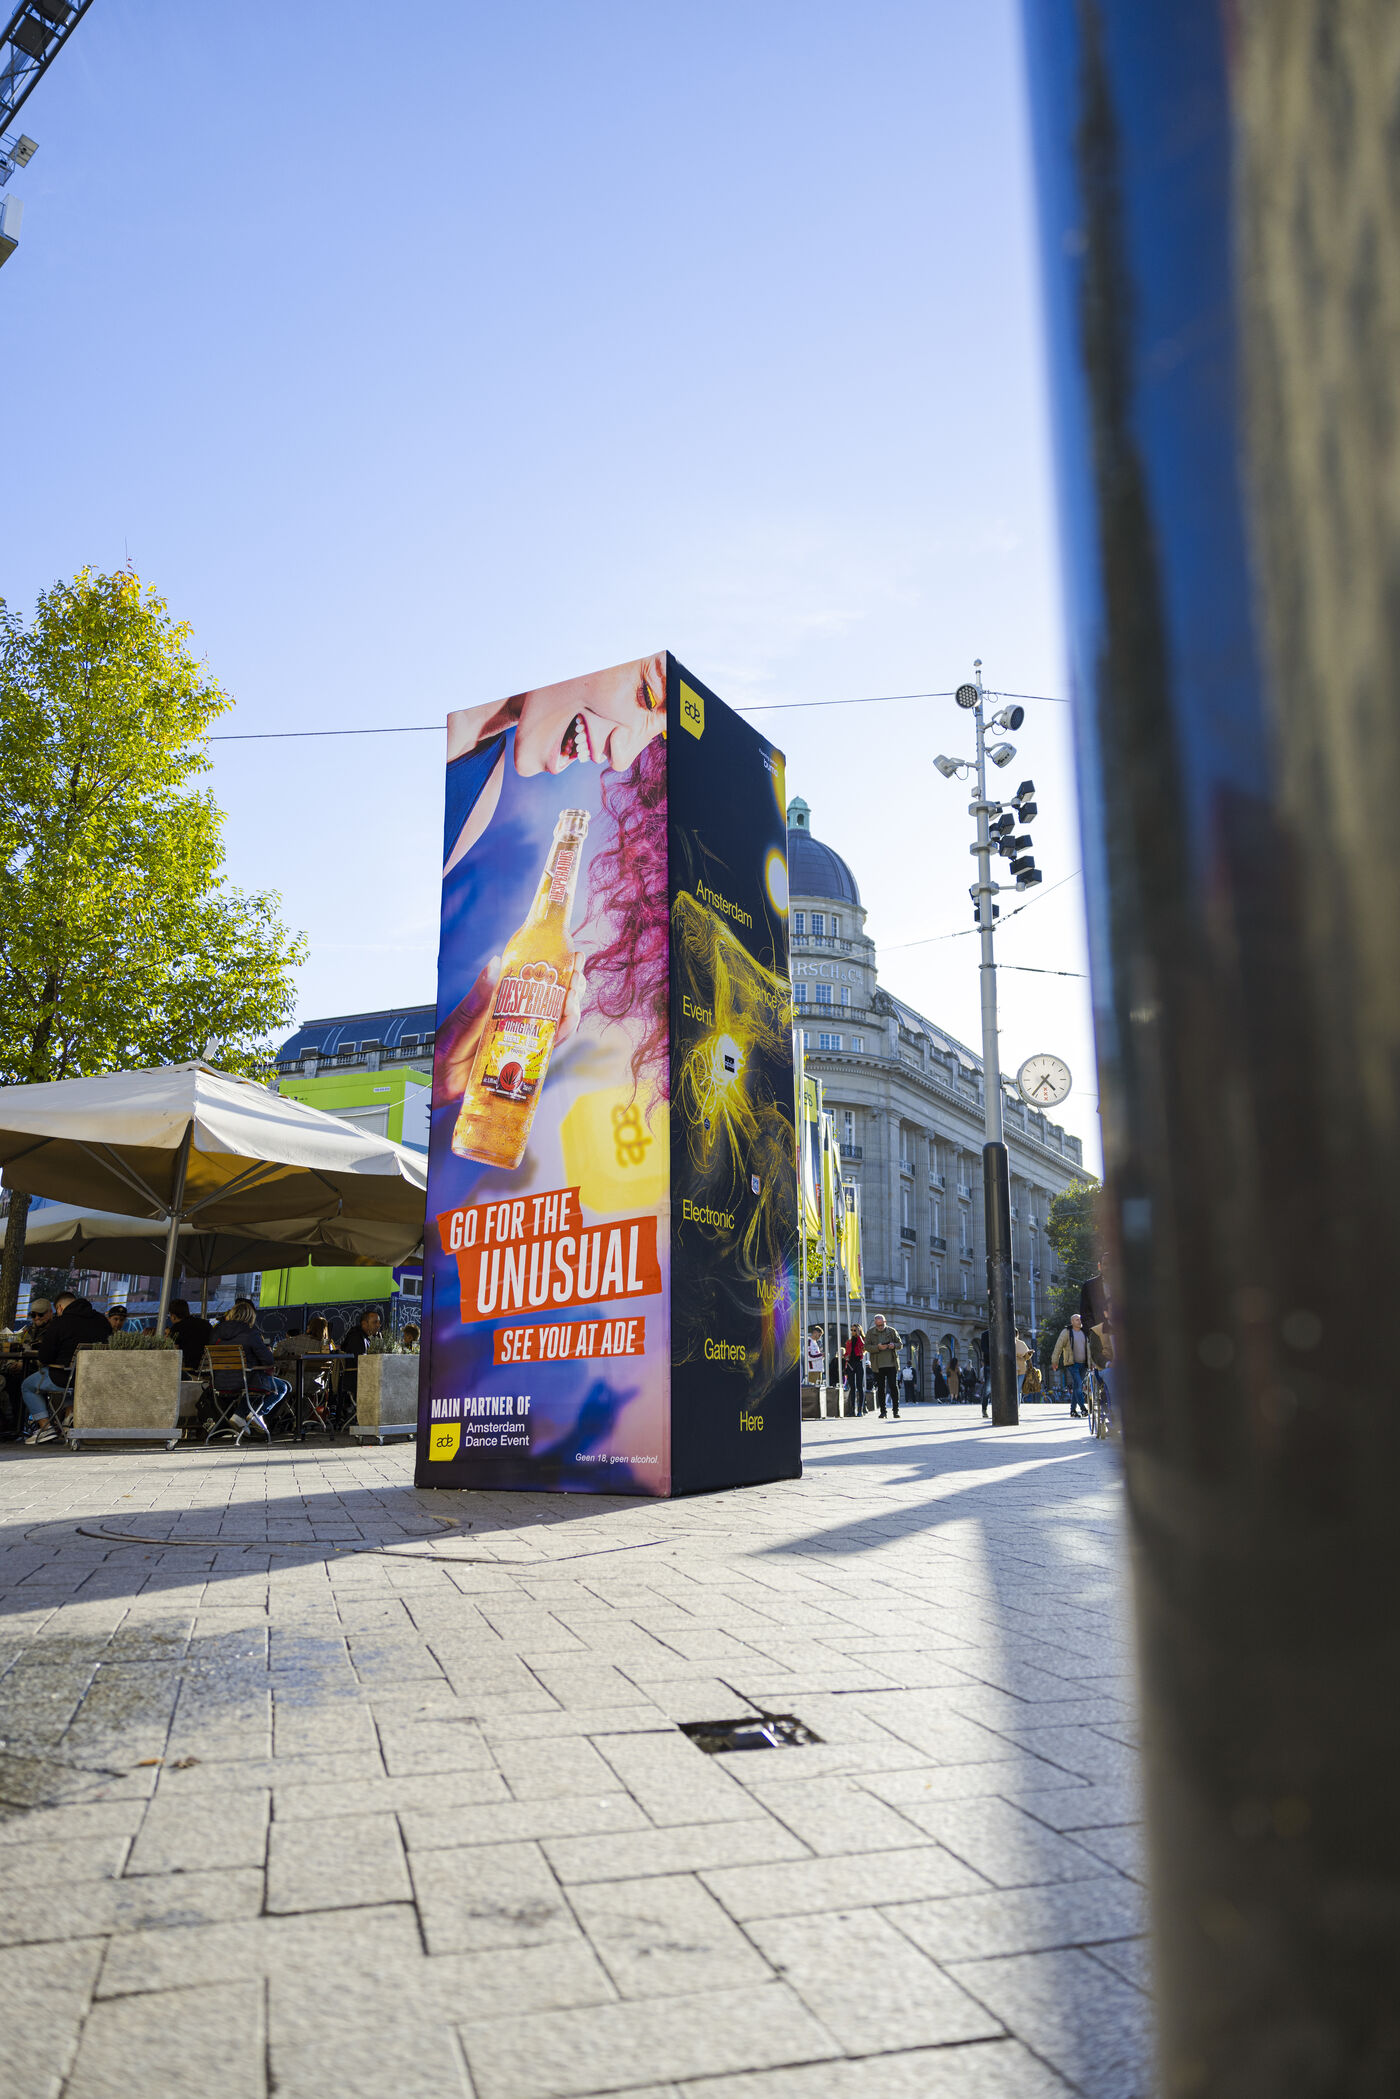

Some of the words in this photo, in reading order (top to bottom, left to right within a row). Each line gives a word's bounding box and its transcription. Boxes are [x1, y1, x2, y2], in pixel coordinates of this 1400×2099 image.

[685, 700, 700, 724] ade
[549, 849, 575, 902] DESPERADOS
[696, 879, 753, 929] Amsterdam
[749, 979, 778, 1009] Dance
[682, 994, 714, 1028] Event
[504, 1020, 541, 1038] ORIGINAL
[449, 1208, 478, 1250] GO
[484, 1201, 525, 1244] FOR
[533, 1191, 573, 1236] THE
[683, 1198, 735, 1230] Electronic
[476, 1225, 643, 1314] UNUSUAL
[756, 1278, 785, 1301] Music
[501, 1329, 534, 1362] SEE
[539, 1325, 572, 1359] YOU
[575, 1323, 599, 1357] AT
[600, 1320, 638, 1355] ADE
[704, 1337, 746, 1361] Gathers
[431, 1398, 460, 1418] MAIN
[463, 1396, 514, 1417] PARTNER
[517, 1395, 532, 1415] OF
[466, 1421, 525, 1433] Amsterdam
[740, 1410, 764, 1432] Here
[436, 1433, 454, 1448] ade
[465, 1436, 498, 1447] Dance
[500, 1434, 530, 1446] Event
[575, 1453, 596, 1462] Geen
[597, 1454, 608, 1463] 18,
[610, 1455, 629, 1464] geen
